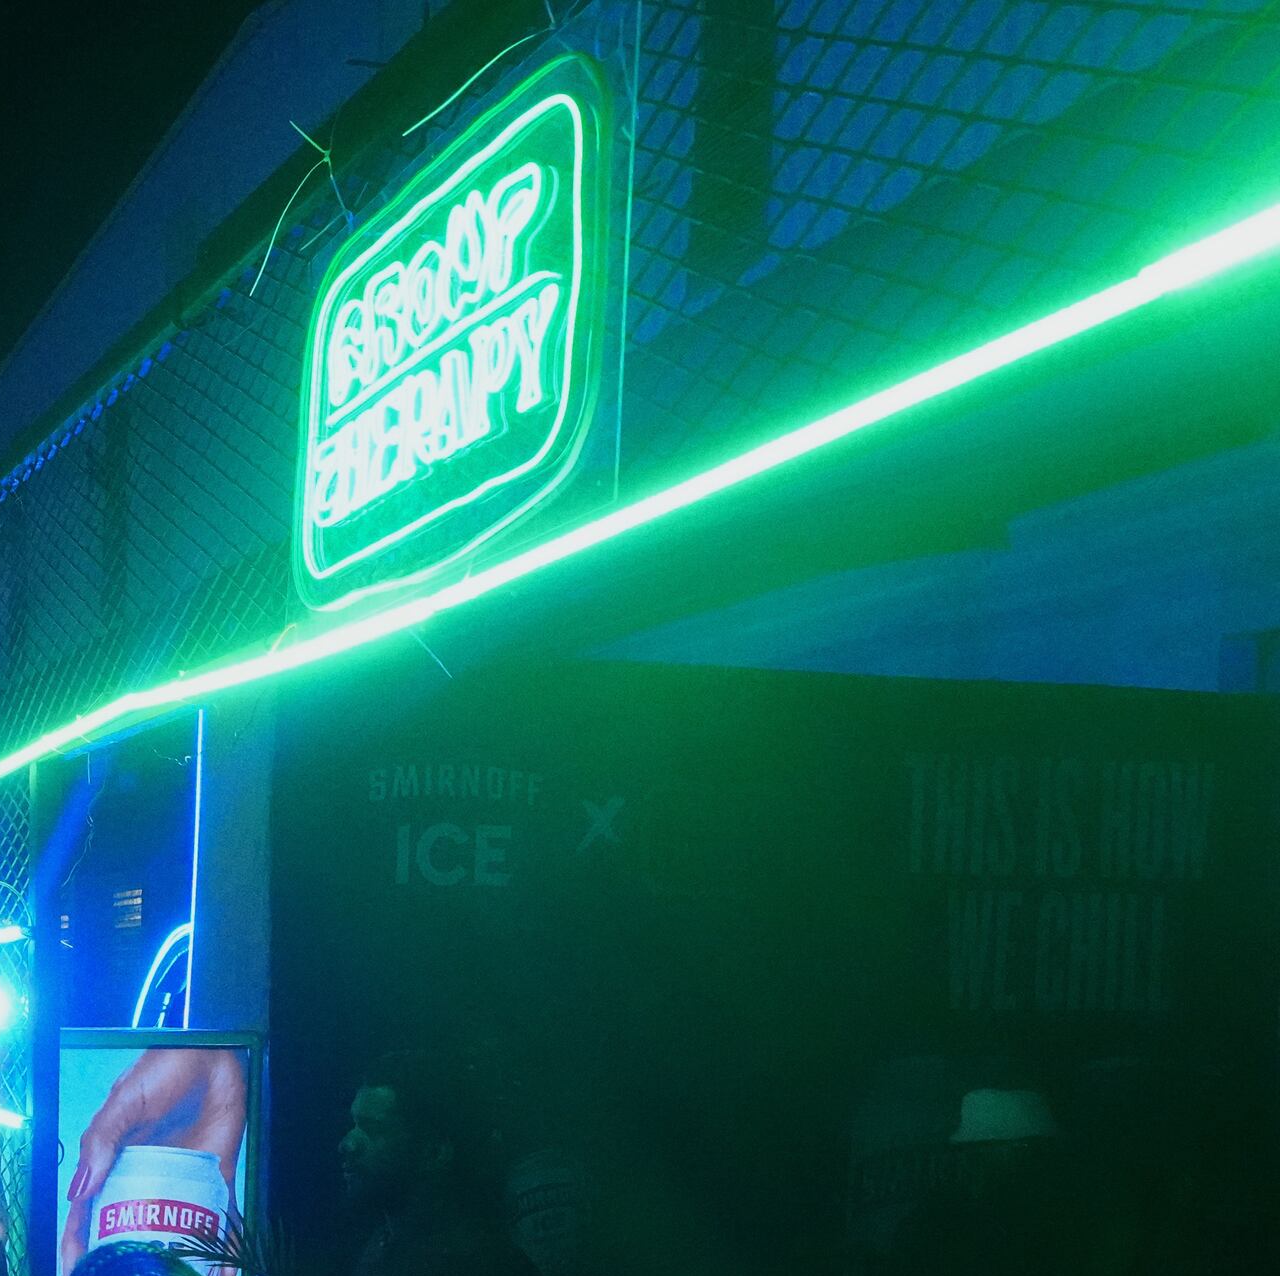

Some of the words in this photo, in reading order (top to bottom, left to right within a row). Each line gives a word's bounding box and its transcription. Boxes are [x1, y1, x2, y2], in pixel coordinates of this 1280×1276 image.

[368, 763, 543, 806] SMIRNOFF
[395, 821, 513, 887] ICE
[105, 1203, 214, 1236] SMIRNOFF
